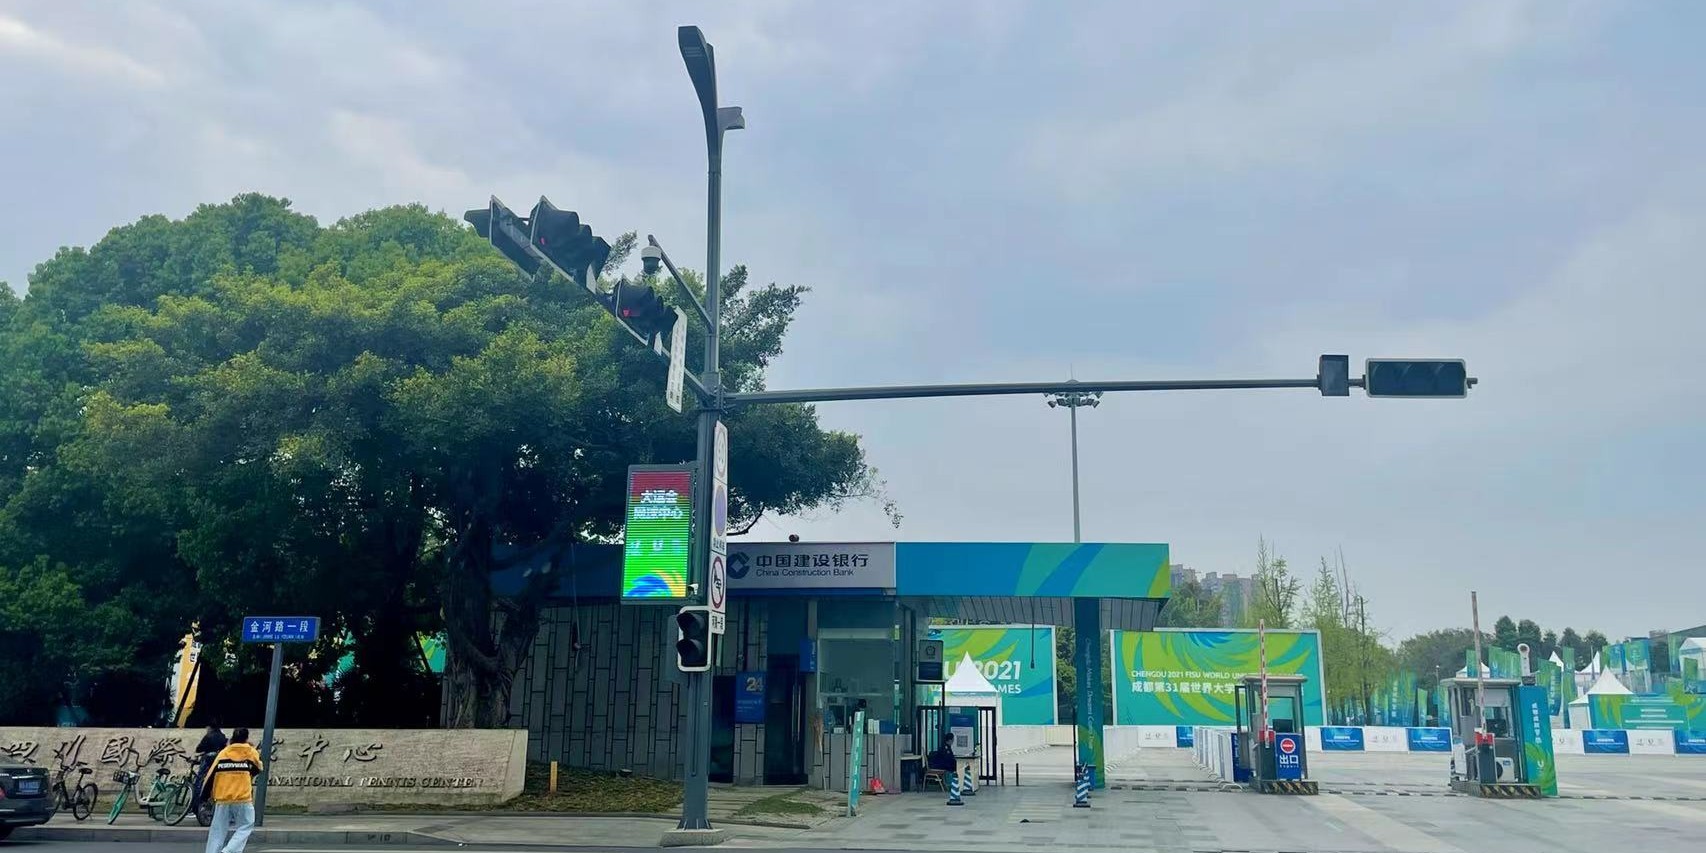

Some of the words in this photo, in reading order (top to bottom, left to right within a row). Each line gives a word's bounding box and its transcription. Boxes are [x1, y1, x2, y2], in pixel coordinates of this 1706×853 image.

[756, 554, 869, 568] 中国建设银行
[756, 569, 779, 577] China
[782, 569, 831, 577] Construction
[249, 620, 309, 633] 金河路一段
[746, 677, 764, 692] 24
[1279, 755, 1299, 764] 出口
